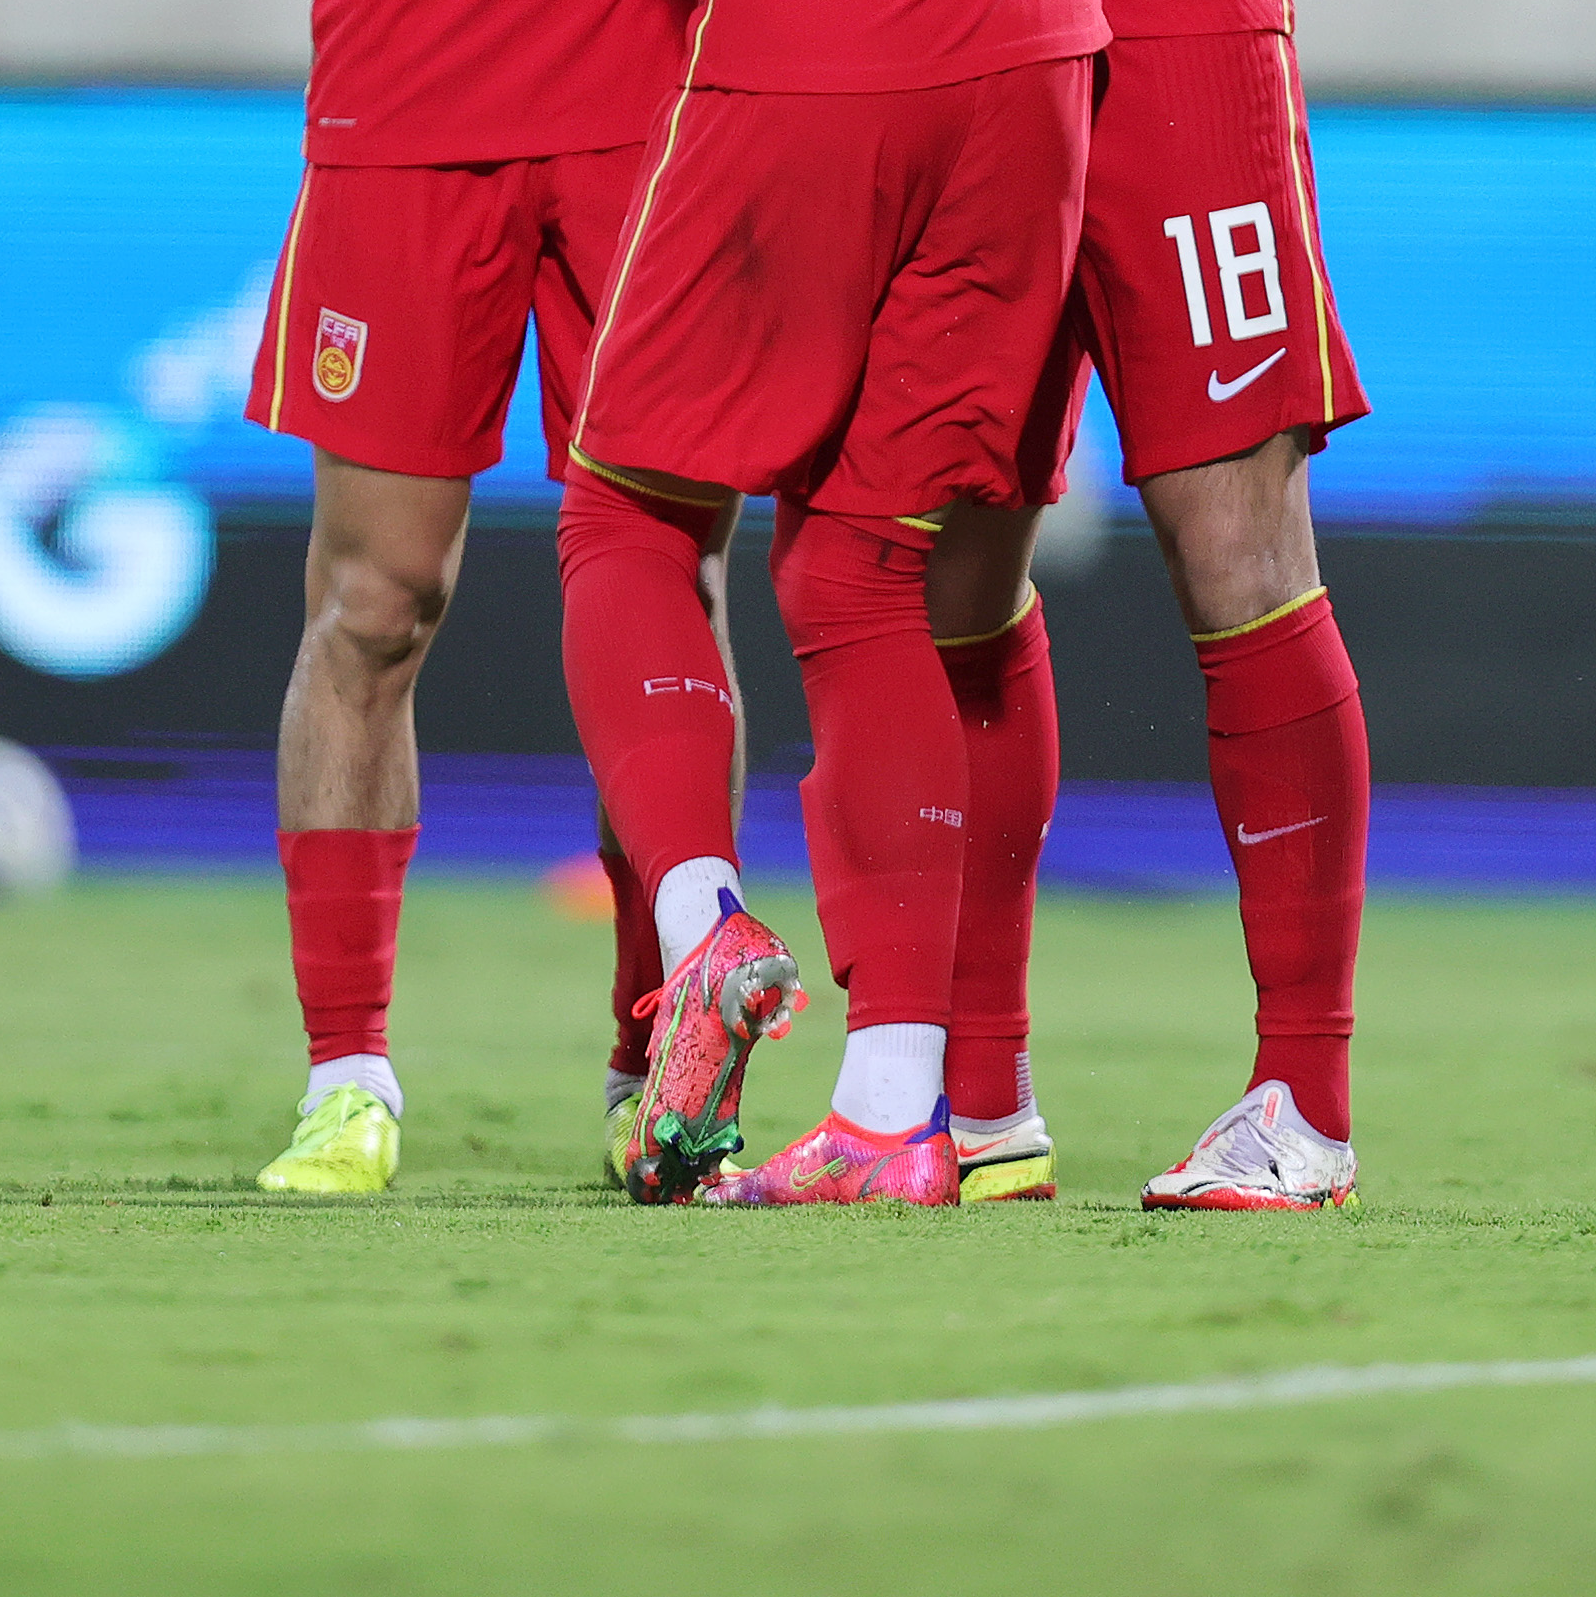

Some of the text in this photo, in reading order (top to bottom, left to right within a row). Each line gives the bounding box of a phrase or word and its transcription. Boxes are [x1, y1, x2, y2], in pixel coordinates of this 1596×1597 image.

[1163, 201, 1288, 347] 18
[322, 316, 359, 342] CFA
[919, 806, 962, 828] 中国
